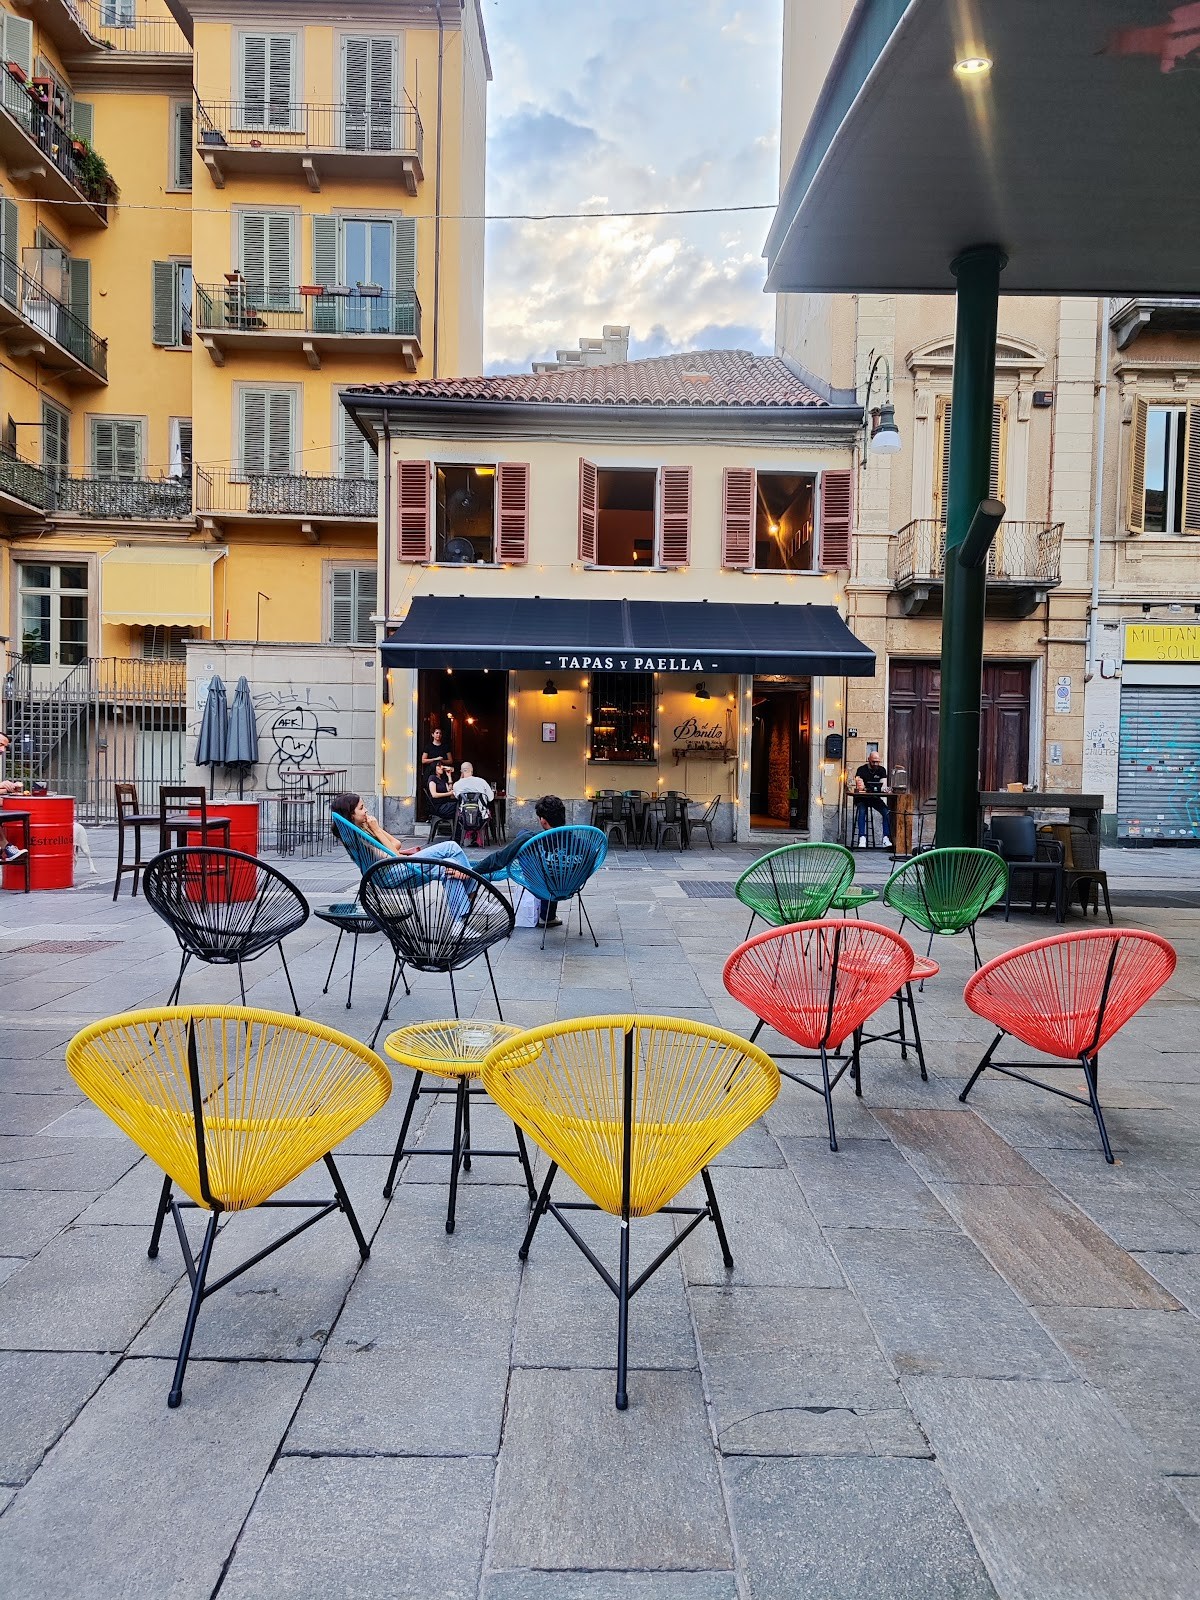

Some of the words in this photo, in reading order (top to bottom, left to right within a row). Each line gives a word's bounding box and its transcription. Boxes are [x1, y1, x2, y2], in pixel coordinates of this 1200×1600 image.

[1132, 627, 1200, 643] MILITAN
[559, 656, 613, 669] TAPAS
[634, 658, 704, 671] PAELLA
[673, 716, 723, 742] Bonito
[29, 836, 69, 846] Estrella
